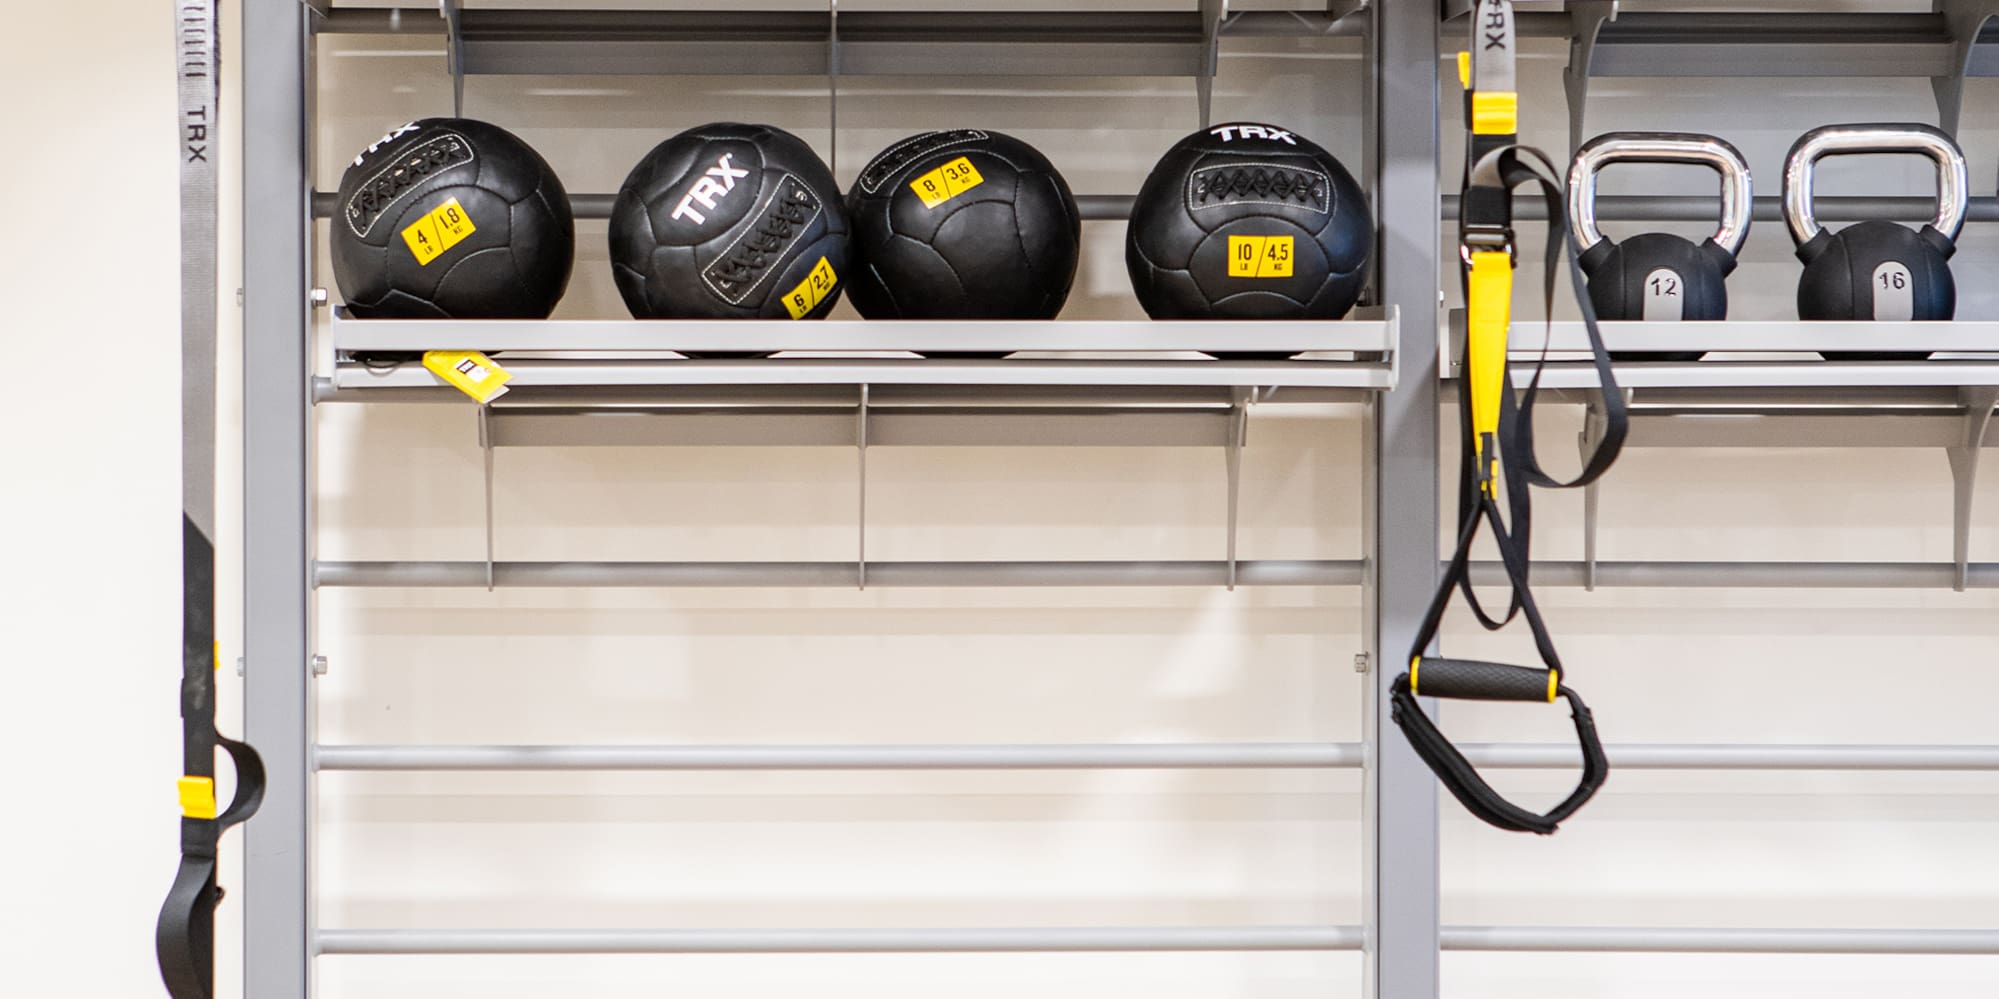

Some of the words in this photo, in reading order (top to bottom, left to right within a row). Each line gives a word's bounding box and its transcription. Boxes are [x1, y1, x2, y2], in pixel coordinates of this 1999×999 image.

[186, 105, 207, 163] TRX
[1210, 125, 1297, 146] TRX
[671, 152, 750, 225] TRX
[922, 179, 936, 193] 8
[945, 162, 971, 181] 3.6
[417, 228, 429, 244] 4
[438, 207, 461, 230] 1.8
[1238, 243, 1252, 261] 10
[1267, 243, 1289, 261] 4.5
[793, 293, 805, 308] 6
[812, 264, 830, 290] 2.7
[1651, 277, 1678, 296] 12
[1879, 271, 1905, 290] 16
